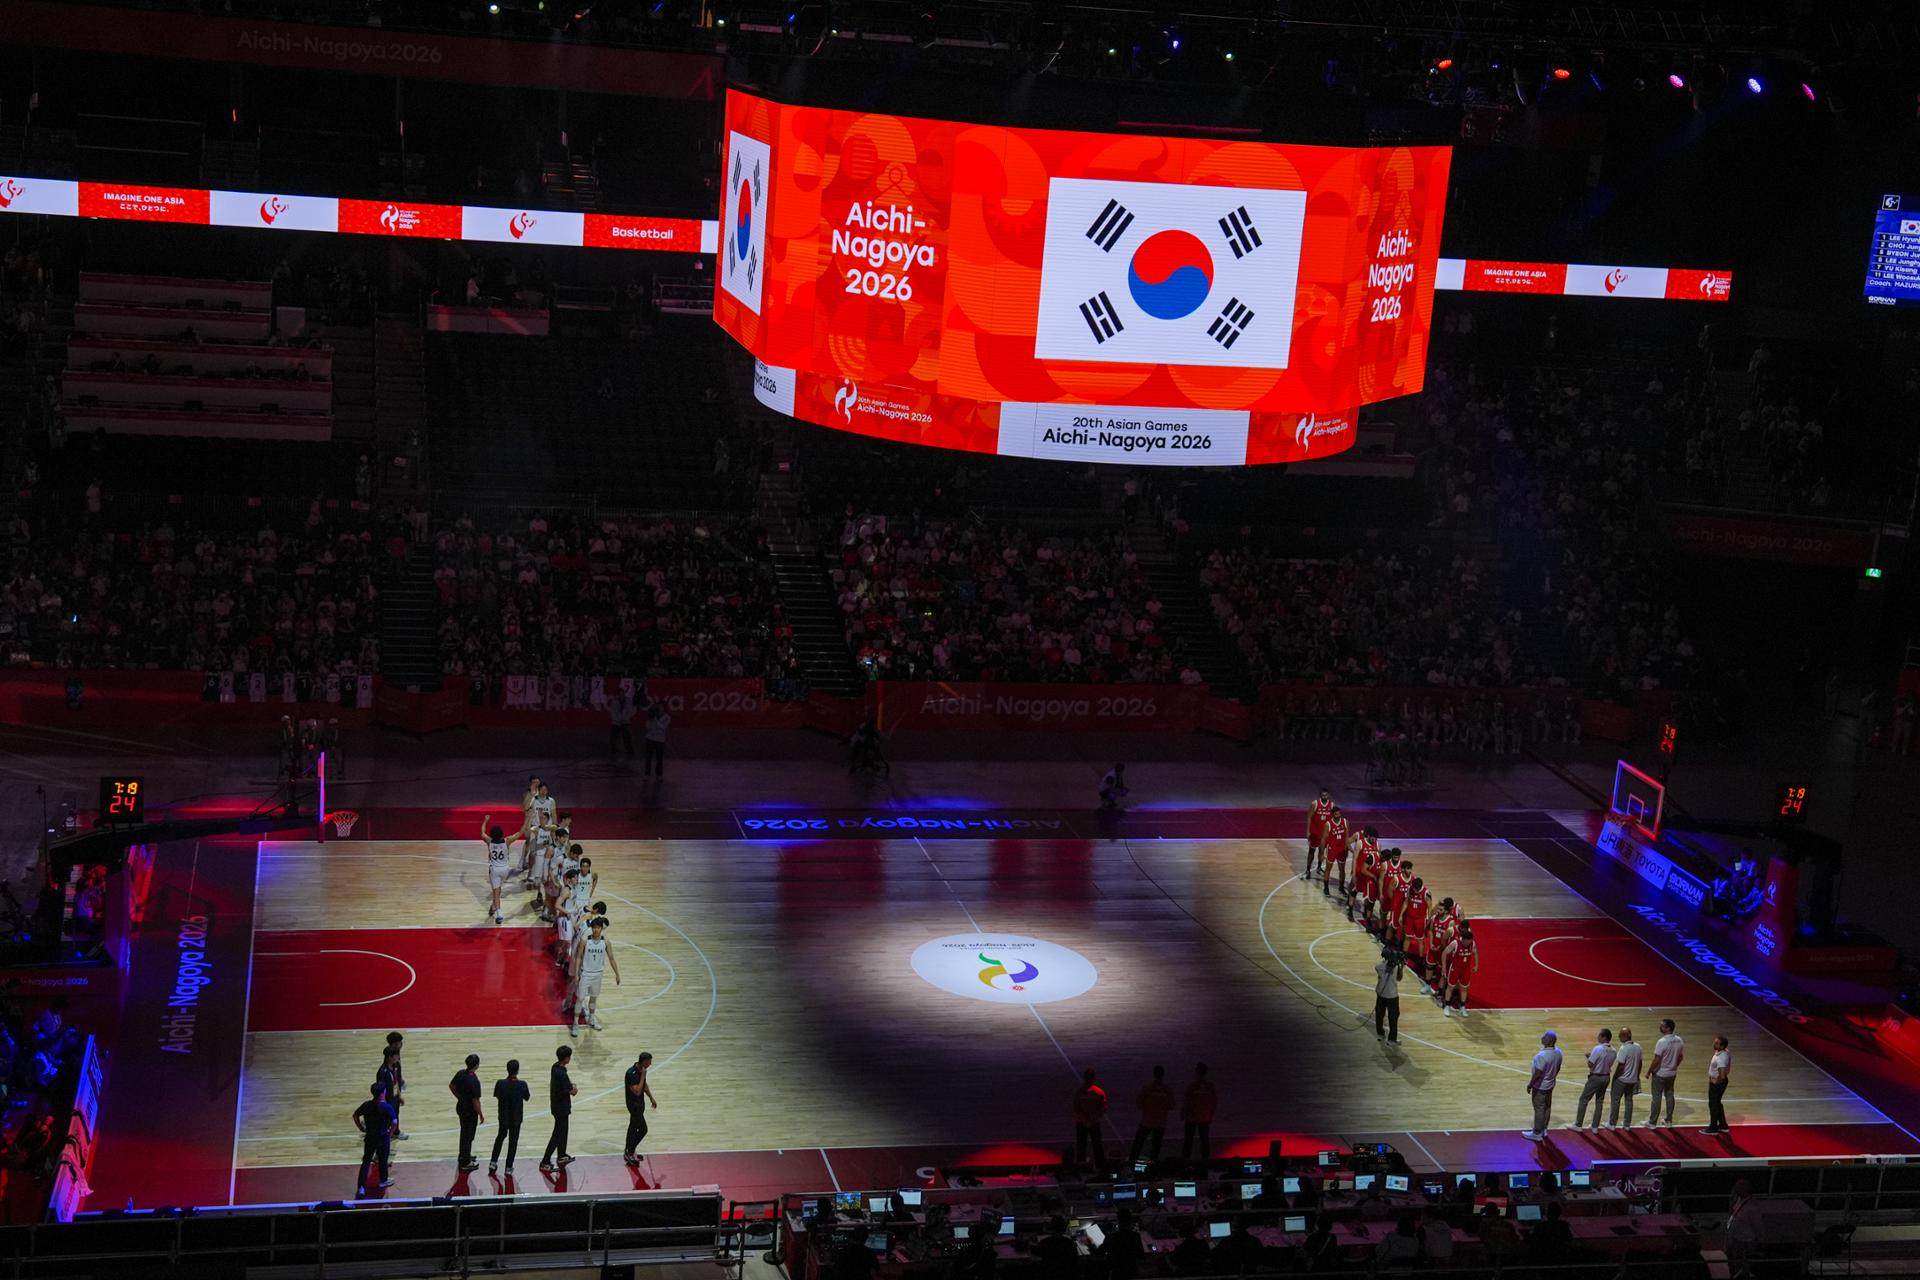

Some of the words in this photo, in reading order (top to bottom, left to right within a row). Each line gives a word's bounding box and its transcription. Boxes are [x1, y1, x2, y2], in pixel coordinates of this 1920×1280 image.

[237, 31, 386, 63] Aichi-Nagoya
[389, 43, 442, 63] 2026
[103, 192, 142, 202] IMAGINE
[143, 196, 162, 204] ONE
[845, 200, 926, 234] Aichi-
[612, 226, 673, 239] Basketball
[1376, 228, 1413, 258] Aichi-
[831, 229, 935, 272] Nagoya
[845, 268, 912, 301] 2026
[1367, 263, 1414, 293] Nagoya
[1484, 268, 1513, 276] IMAGINE
[1370, 295, 1401, 323] 2026
[857, 403, 909, 420] Aichi-Nagoya
[911, 412, 933, 423] 2026
[1072, 416, 1102, 428] 20th
[1106, 419, 1141, 430] Asian
[1144, 420, 1188, 432] Games
[1042, 427, 1166, 452] Aichi-Nagoya
[1171, 435, 1212, 449] 2026
[693, 691, 757, 712] 2026
[920, 694, 1089, 721] Aichi-Nagoya
[1096, 697, 1157, 717] 2026
[110, 795, 135, 813] 24
[1781, 799, 1802, 815] 24
[743, 817, 830, 831] 2026
[838, 815, 1062, 832] Aichi-Nagoya
[491, 850, 505, 861] 36
[1636, 851, 1666, 879] TOYOTA
[1669, 873, 1704, 901] BORNAN
[177, 915, 208, 949] 2026
[1627, 904, 1759, 987] Aichi-Nagoya
[159, 951, 213, 1056] Aichi-Nagoya
